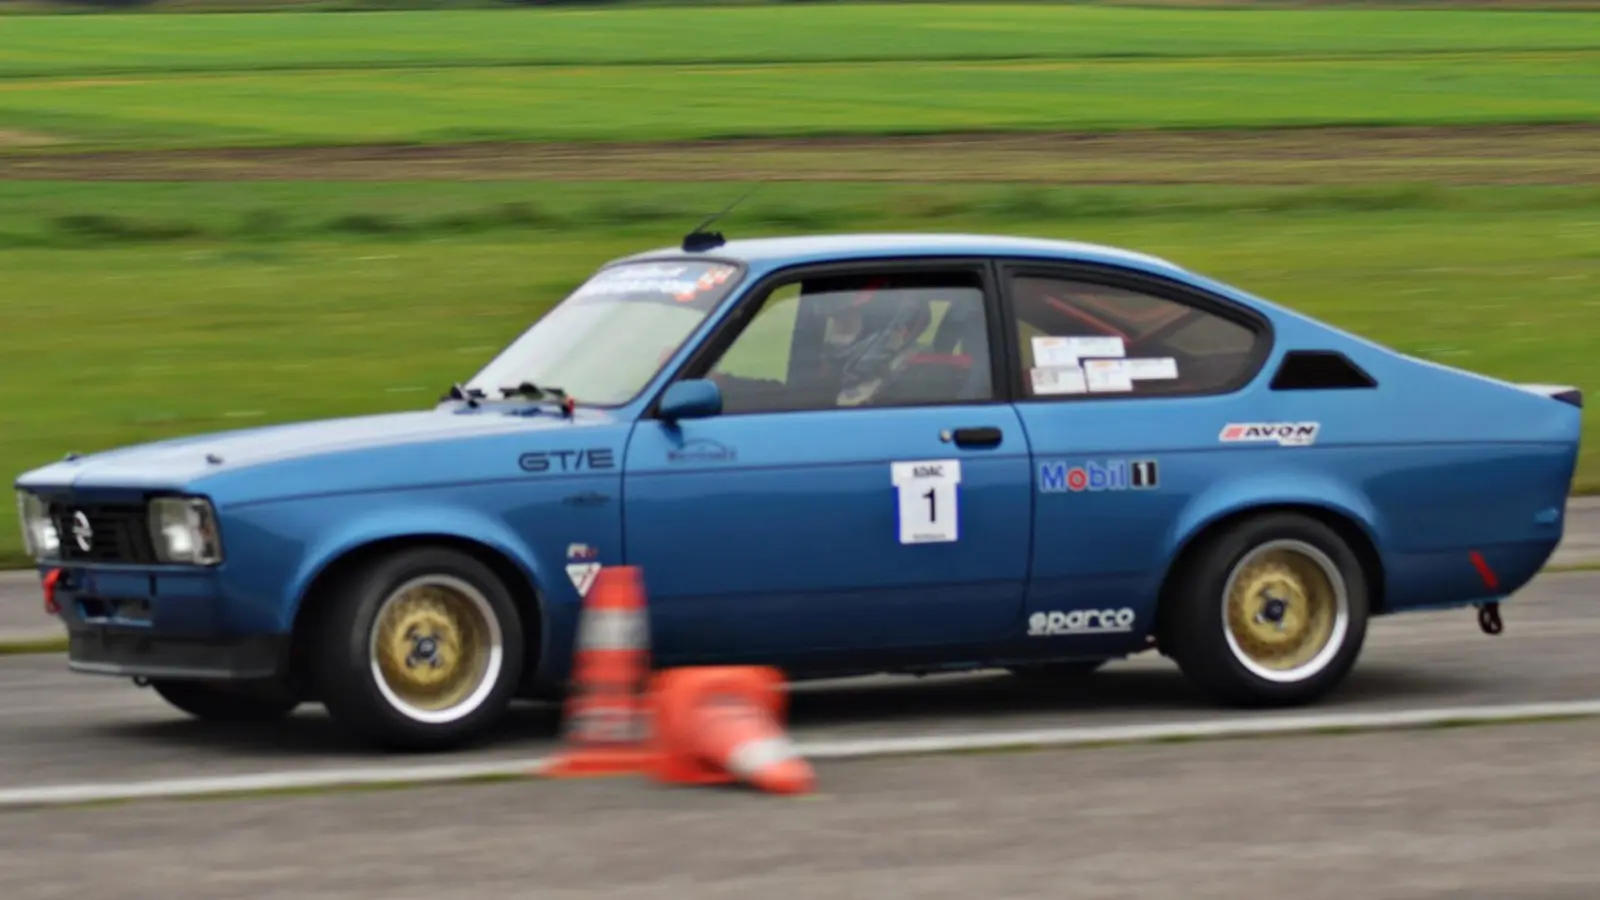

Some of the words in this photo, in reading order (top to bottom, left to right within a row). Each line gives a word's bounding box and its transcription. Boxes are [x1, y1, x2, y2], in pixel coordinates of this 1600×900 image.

[1246, 425, 1314, 438] AVON
[518, 448, 614, 472] GT/E
[912, 466, 945, 479] ADAC
[1041, 461, 1126, 491] Mobil
[1134, 462, 1153, 487] 1
[922, 487, 936, 523] 1
[1028, 607, 1135, 635] sparco
